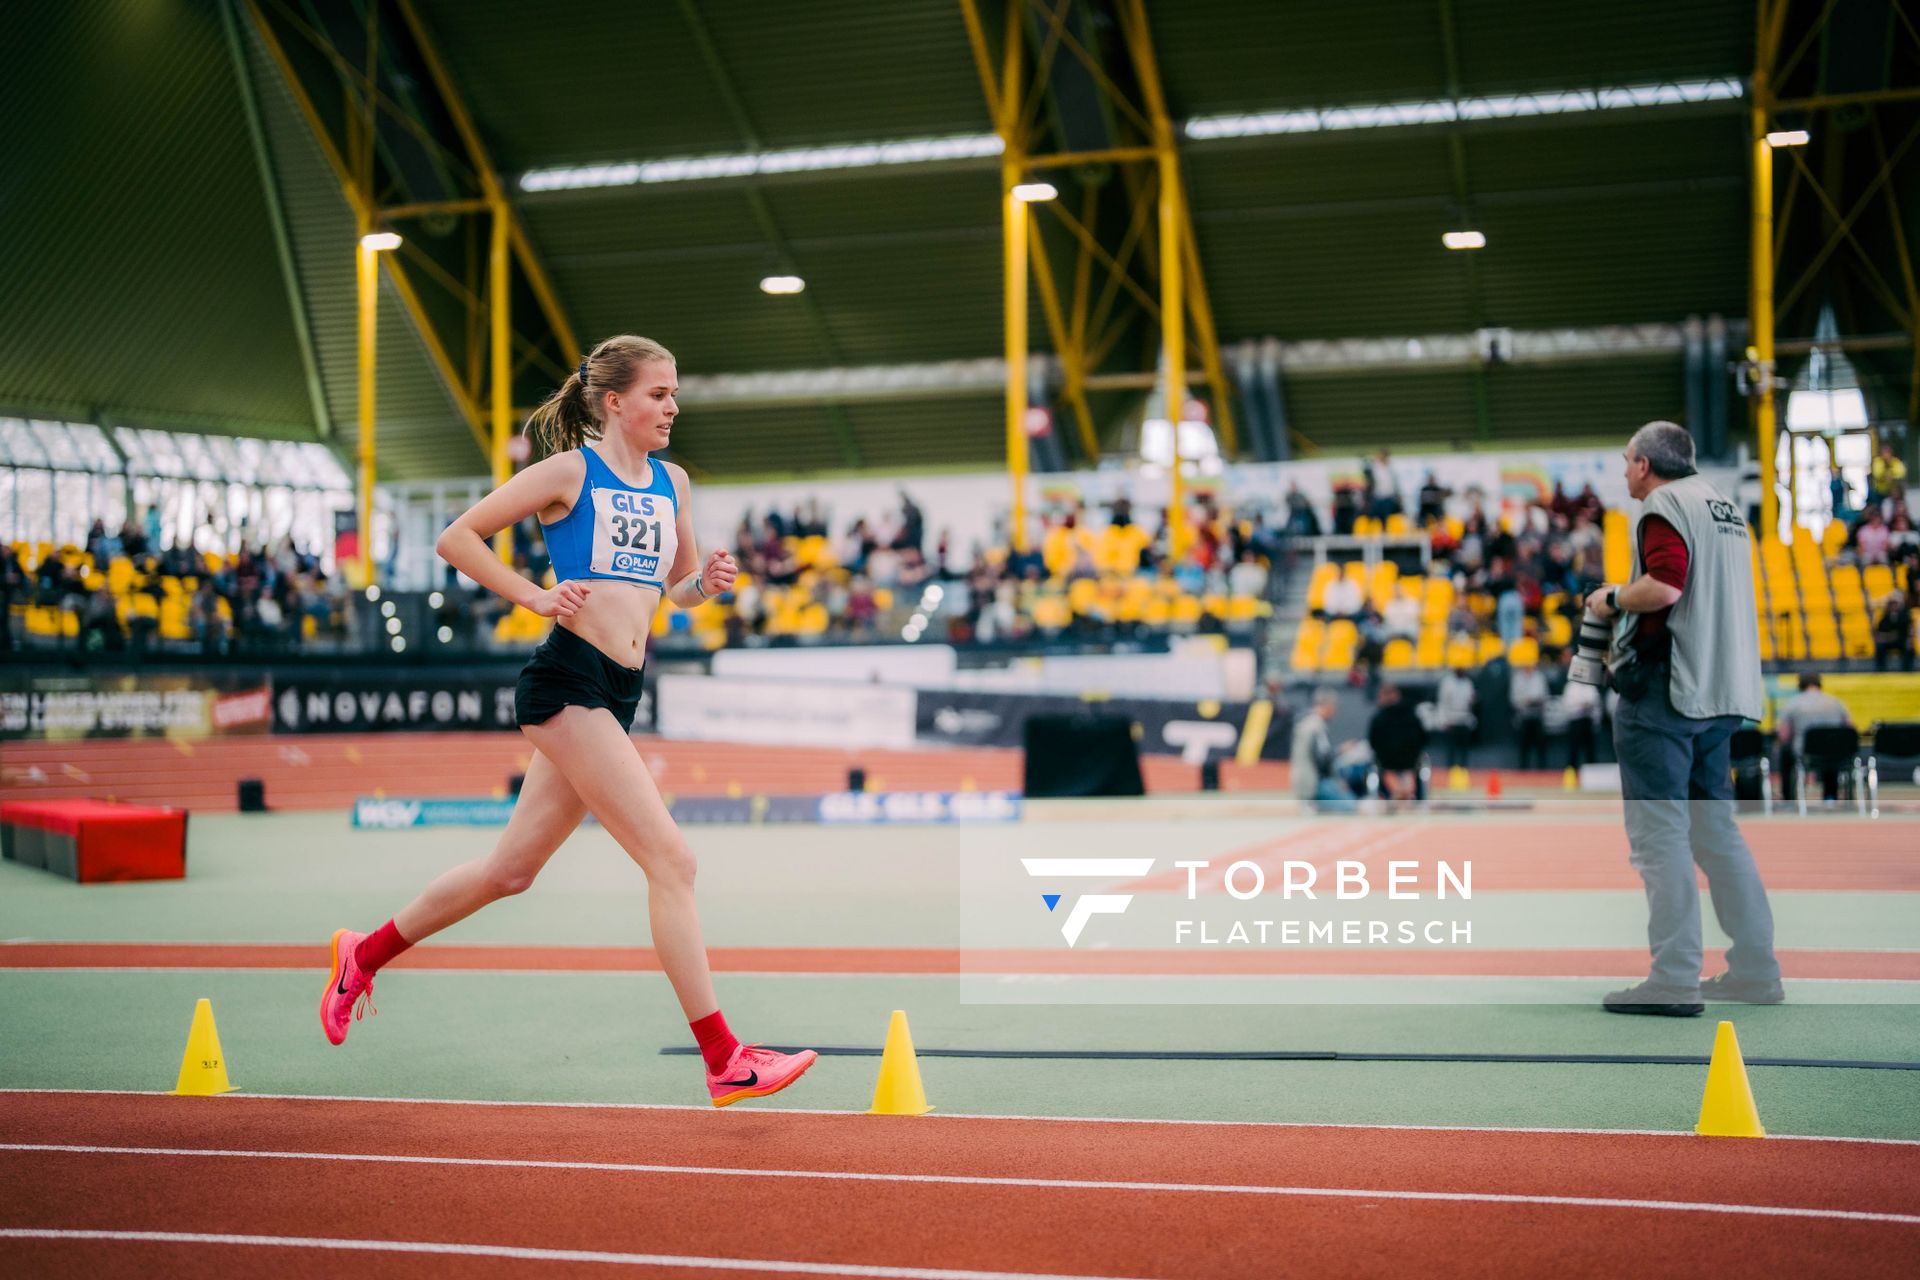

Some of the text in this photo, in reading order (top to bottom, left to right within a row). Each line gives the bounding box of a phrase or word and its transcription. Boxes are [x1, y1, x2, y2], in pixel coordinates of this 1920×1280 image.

[611, 493, 655, 516] GLS
[611, 515, 661, 552] 321
[633, 557, 657, 570] PLAN
[306, 691, 482, 723] NOVAFON
